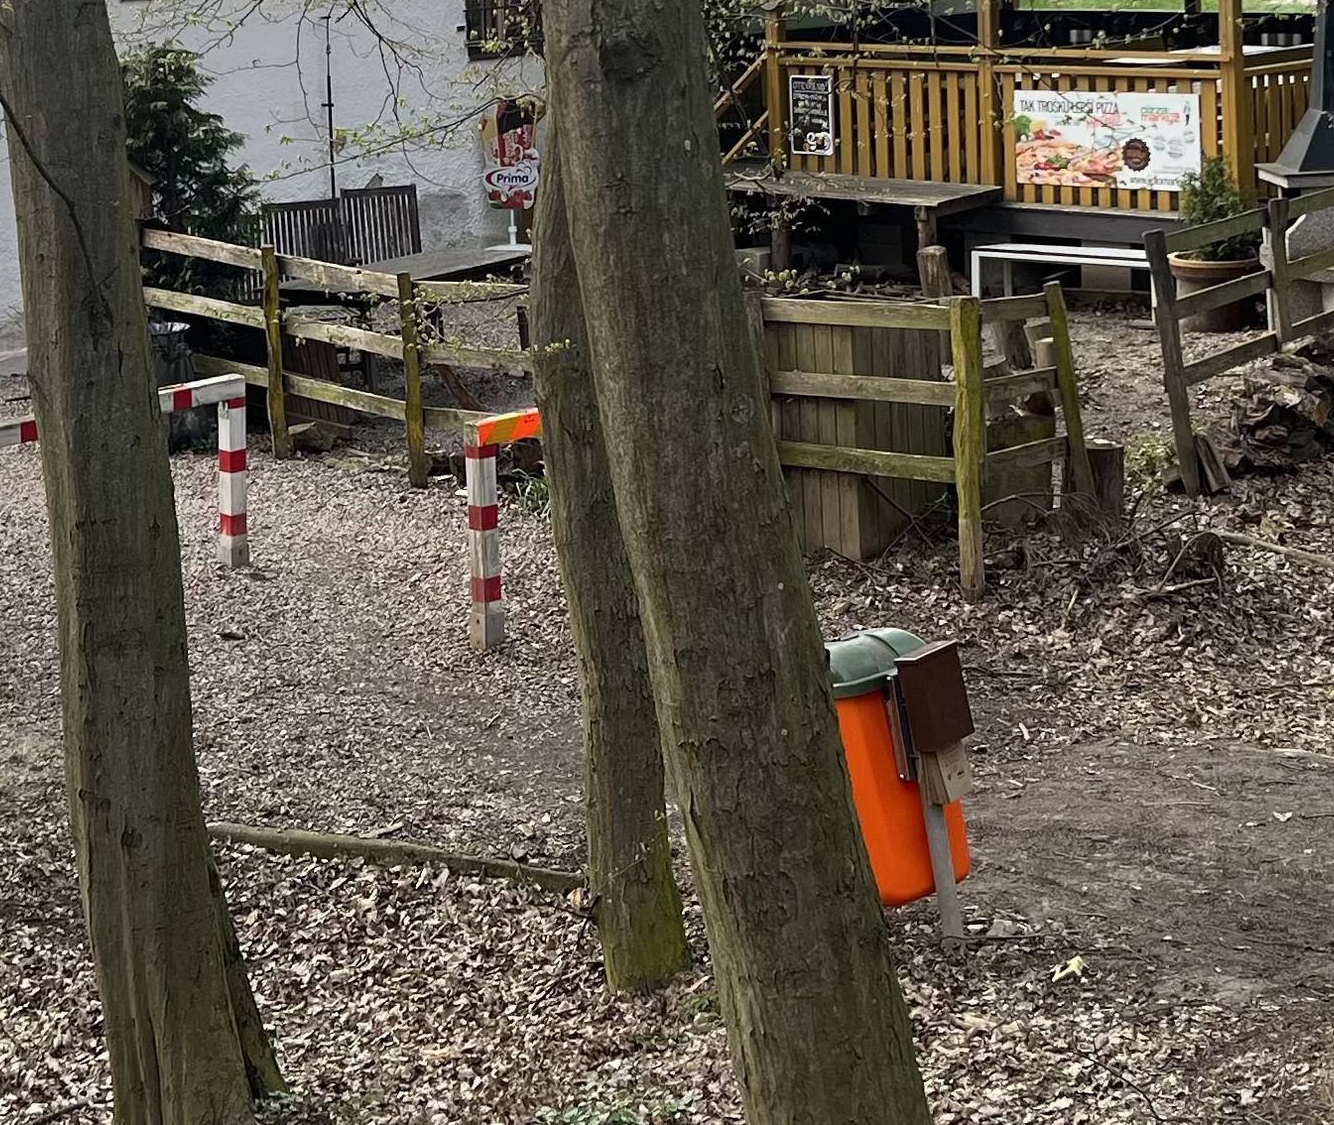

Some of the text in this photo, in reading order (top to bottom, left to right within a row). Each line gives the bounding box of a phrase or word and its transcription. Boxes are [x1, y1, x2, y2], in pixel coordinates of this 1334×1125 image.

[1020, 100, 1036, 112] TAK
[1096, 101, 1119, 114] PIZZA
[496, 174, 529, 184] Prima
